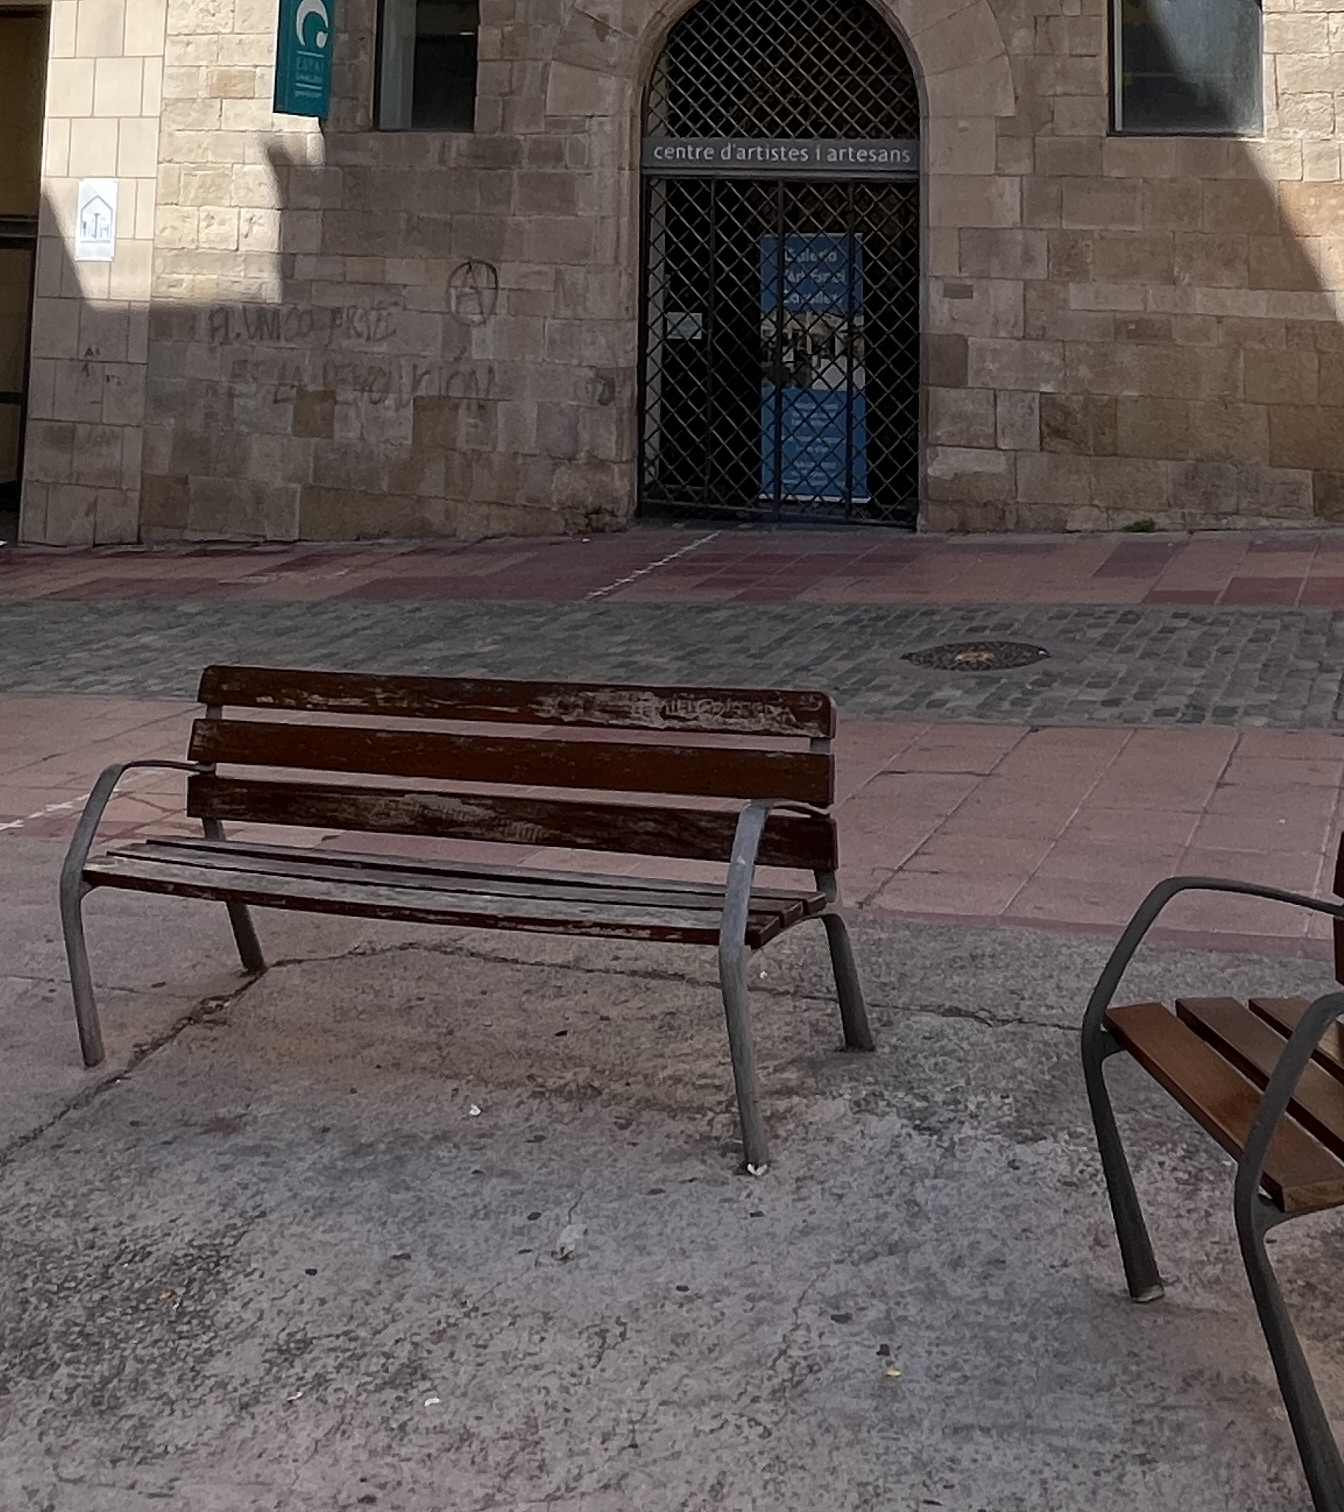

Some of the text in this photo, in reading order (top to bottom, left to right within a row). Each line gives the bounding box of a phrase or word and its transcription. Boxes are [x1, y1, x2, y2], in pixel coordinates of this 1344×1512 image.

[653, 142, 911, 164] centre d'artistes i artesans
